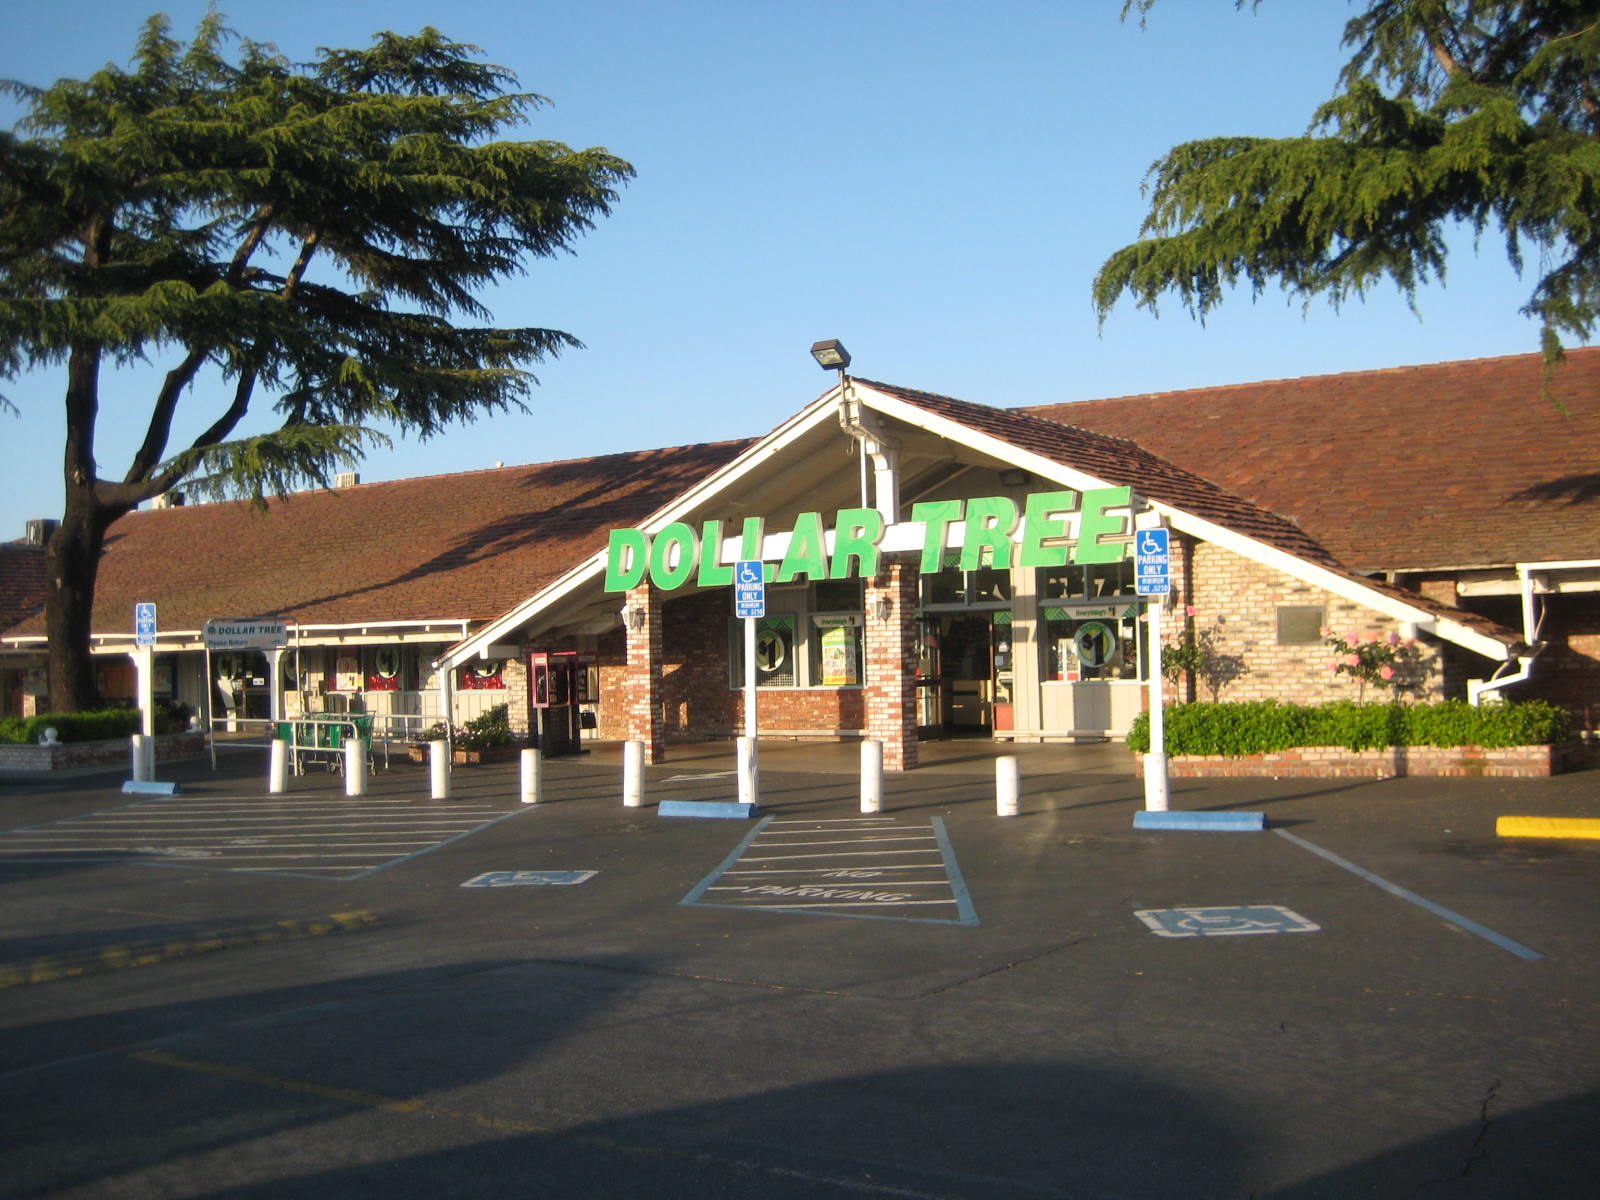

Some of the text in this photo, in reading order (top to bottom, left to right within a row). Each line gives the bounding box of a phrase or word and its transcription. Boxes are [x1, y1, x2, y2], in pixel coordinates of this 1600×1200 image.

[604, 486, 1132, 592] DOLLAR TREE
[1138, 554, 1168, 565] PARKING
[1143, 565, 1162, 575] ONLY
[737, 582, 763, 592] PARKING
[742, 591, 758, 601] ONLY
[218, 625, 284, 635] DOLLAR TREE
[742, 885, 912, 902] PARKING
